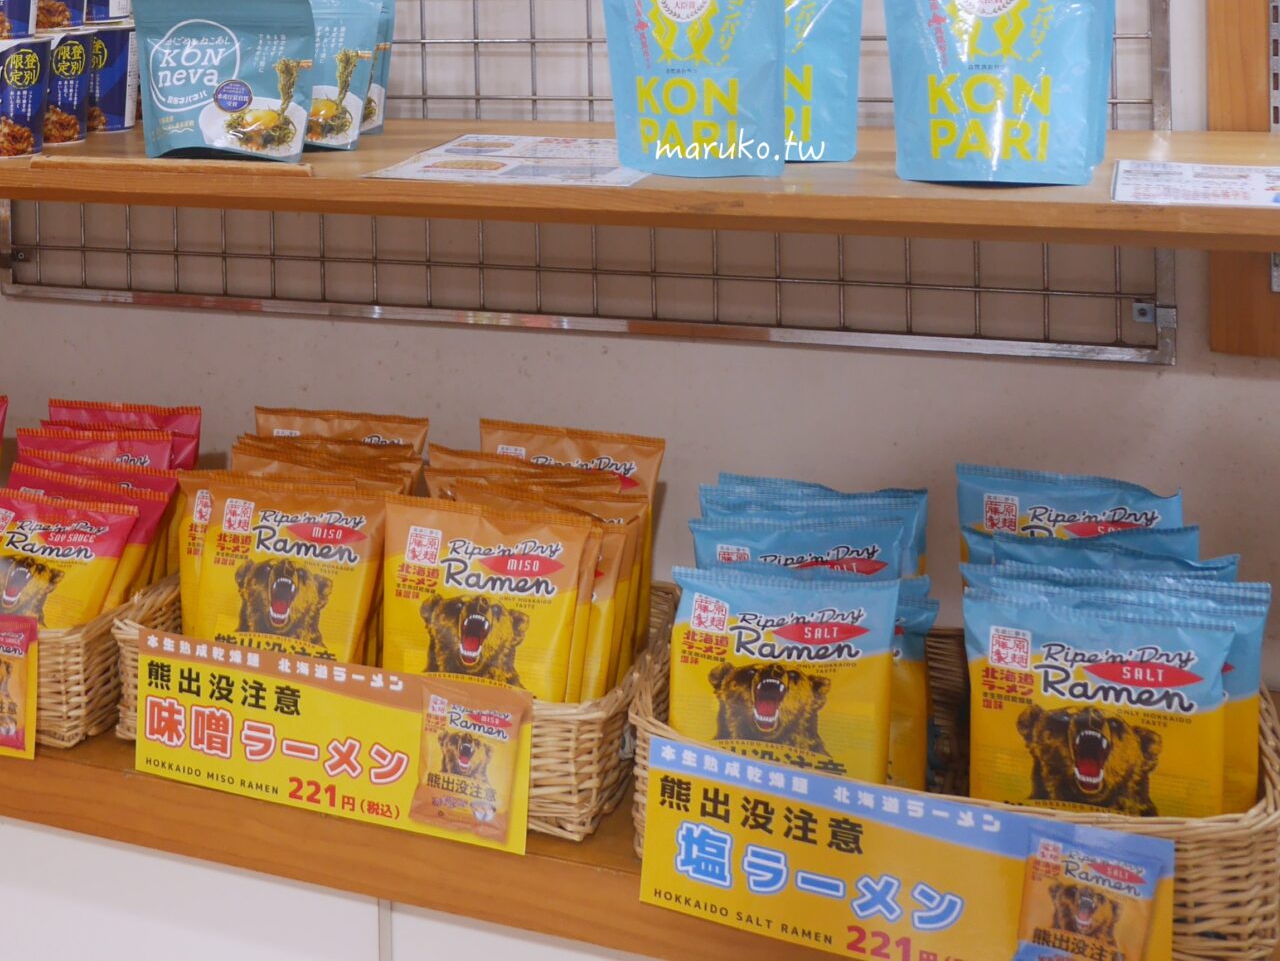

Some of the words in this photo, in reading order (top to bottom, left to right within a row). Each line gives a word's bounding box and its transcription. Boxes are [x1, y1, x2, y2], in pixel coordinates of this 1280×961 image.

[160, 47, 225, 68] KON
[158, 68, 219, 88] neva
[636, 76, 739, 116] KON
[927, 73, 1052, 116] KON
[640, 118, 739, 159] PARI
[929, 119, 1050, 161] PARI
[1109, 508, 1158, 527] Dry
[48, 533, 67, 542] SOY
[67, 534, 96, 543] SAUCE
[312, 527, 343, 538] MISO
[5, 531, 94, 559] Ramen
[216, 543, 251, 553] ラーメン
[252, 526, 358, 563] Ramen
[522, 541, 561, 558] Dry
[398, 564, 439, 578] 北海道
[507, 559, 540, 571] MISO
[397, 574, 438, 587] ラーメン
[440, 558, 555, 595] Ramen
[819, 609, 864, 626] Dry
[683, 630, 729, 647] 北海道
[729, 625, 860, 660] Ramen
[804, 626, 839, 638] SALT
[681, 641, 728, 656] ラーメン
[1137, 647, 1194, 670] Dry
[278, 658, 404, 691] 北海道ラーメン
[982, 666, 1034, 686] 北海道
[1122, 666, 1164, 682] SALT
[147, 660, 301, 717] 熊出没注意
[982, 679, 1034, 696] ラーメン
[1034, 664, 1194, 712] Ramen
[982, 700, 1004, 710] 塩味
[1140, 719, 1168, 728] TASTE
[1143, 712, 1192, 724] HOKKAIDO
[145, 696, 409, 785] 味噌ラーメン
[145, 757, 202, 778] HOKKAIDO
[207, 772, 235, 785] MISO
[240, 779, 279, 795] RAMEN
[427, 772, 497, 801] 熊出没注意
[288, 776, 400, 819] 221円(税込)
[659, 774, 864, 855] 熊出没注意
[833, 786, 1001, 832] 北海道ラーメン
[676, 822, 964, 931] 塩ラーメン
[654, 887, 729, 917] HOKKAIDO
[736, 910, 773, 930] SALT
[780, 923, 834, 945] RAMEN
